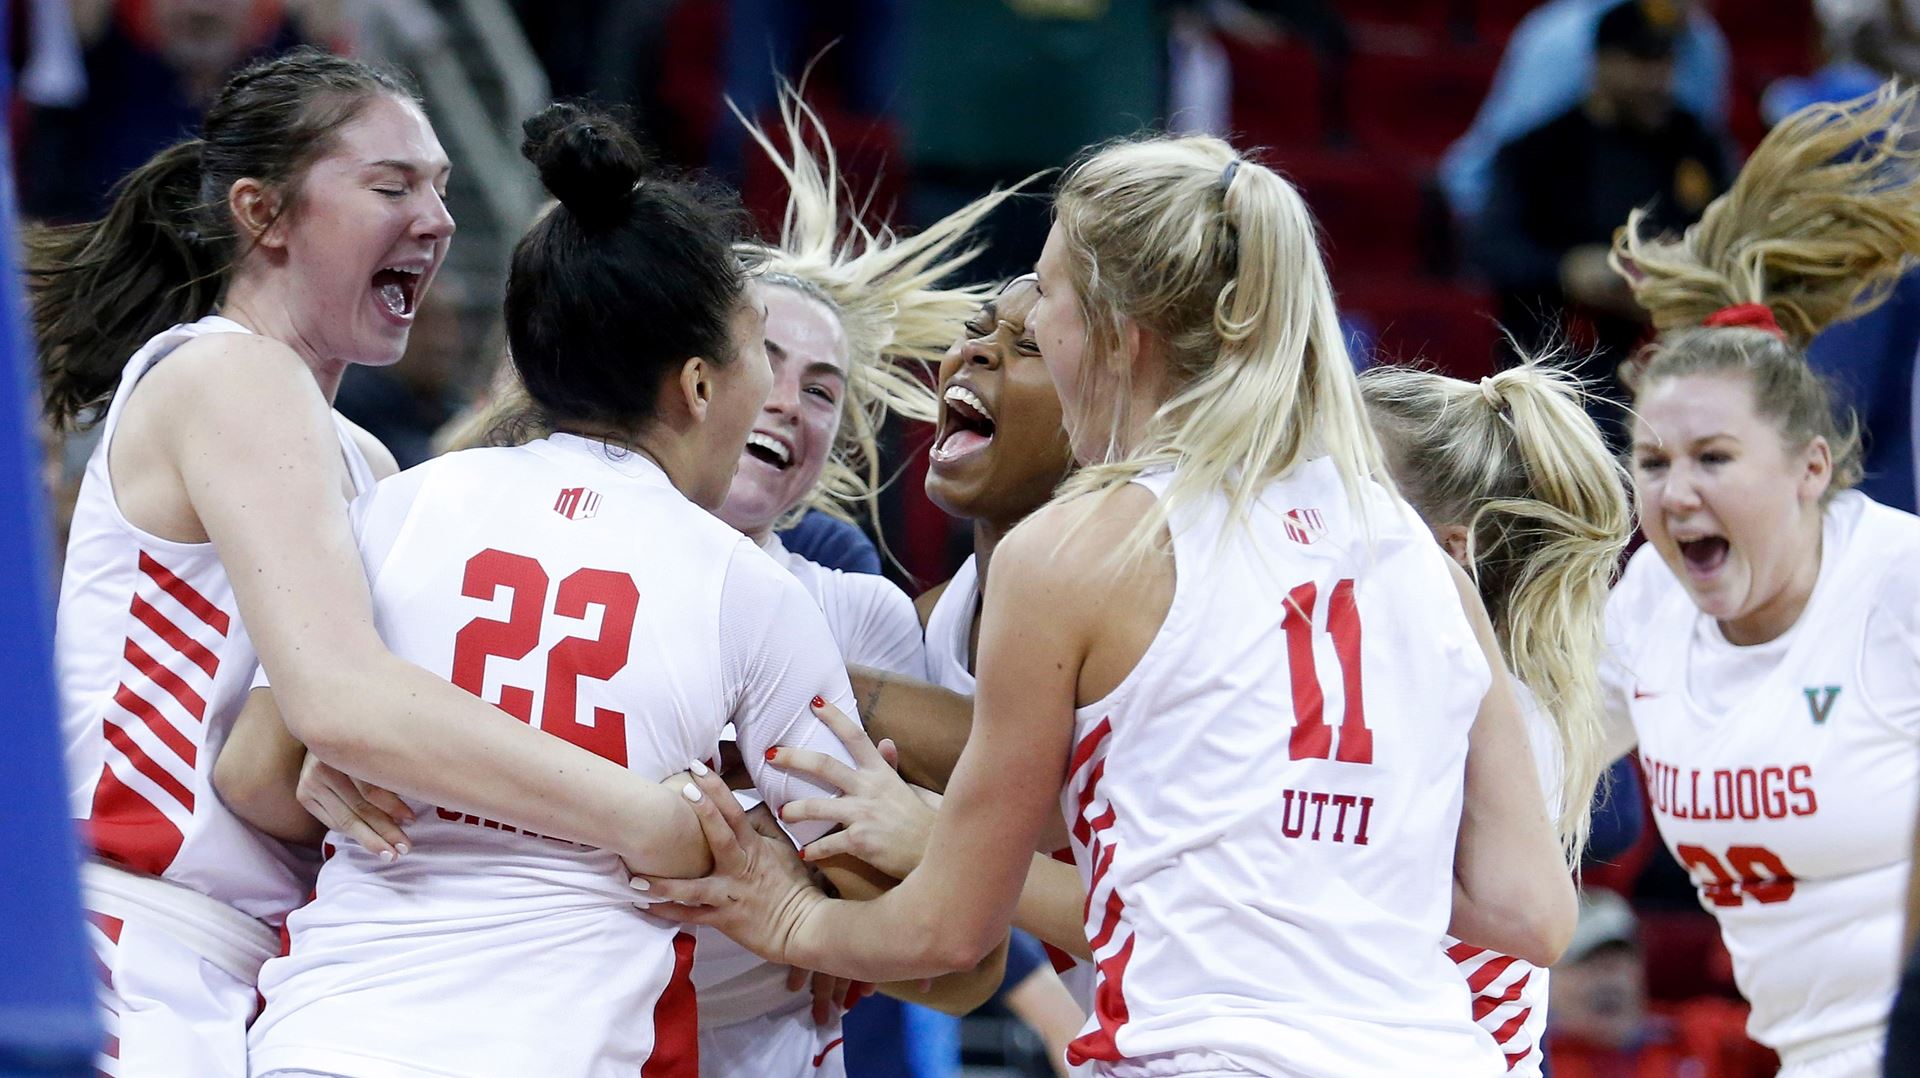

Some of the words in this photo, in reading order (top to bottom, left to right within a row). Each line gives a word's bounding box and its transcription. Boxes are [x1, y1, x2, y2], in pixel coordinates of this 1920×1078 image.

[451, 548, 640, 769] 22
[1281, 578, 1373, 764] 11
[1804, 685, 1842, 724] V
[1282, 789, 1374, 845] UTTI
